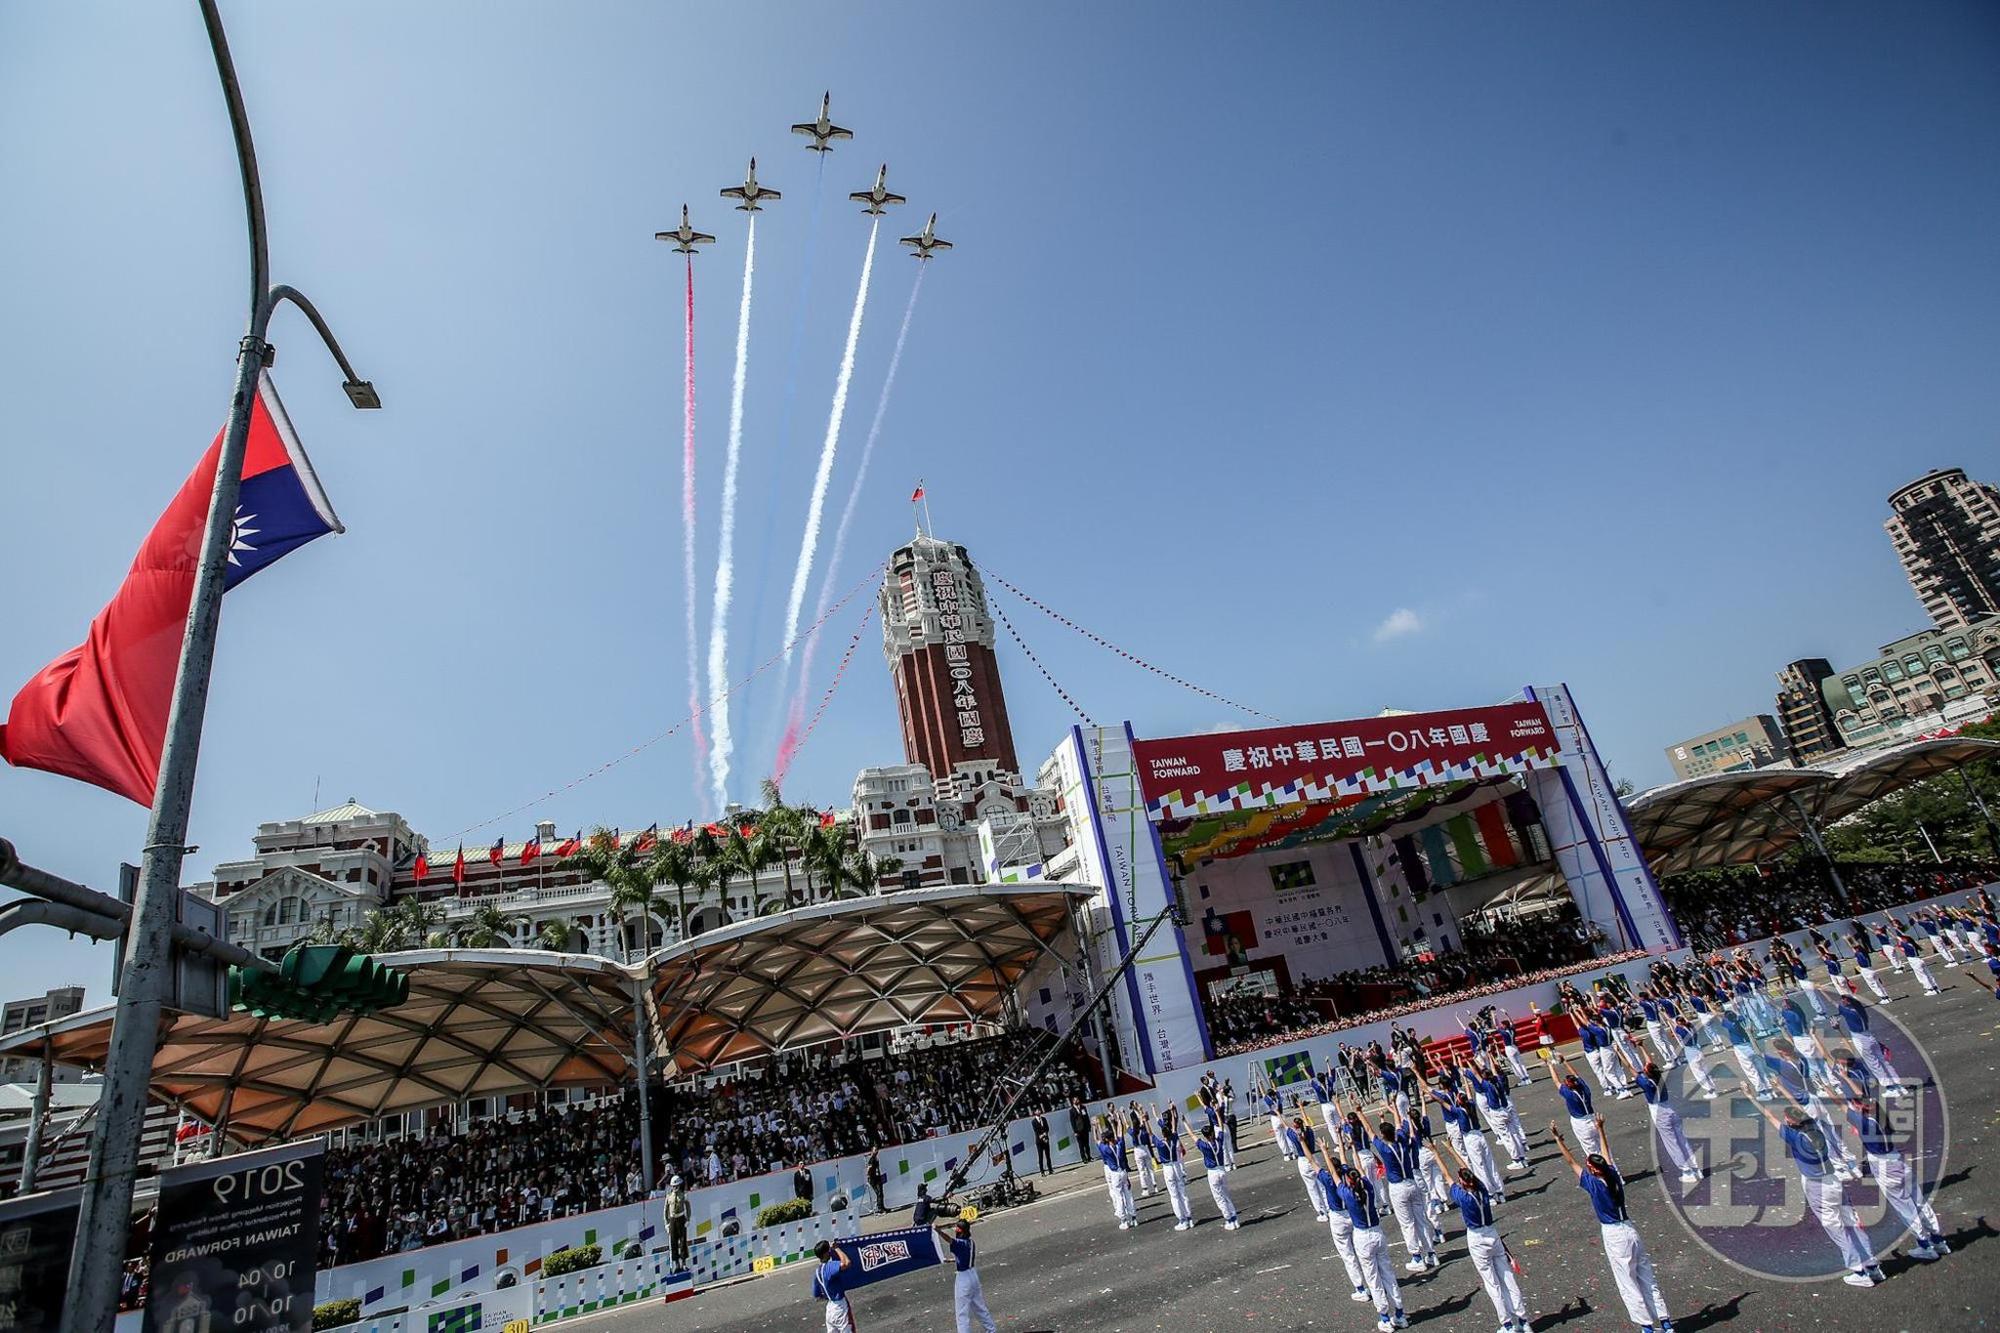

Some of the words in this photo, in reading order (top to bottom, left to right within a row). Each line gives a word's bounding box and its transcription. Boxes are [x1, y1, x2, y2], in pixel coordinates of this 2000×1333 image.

[1513, 718, 1542, 729] TAIWAN
[1510, 726, 1546, 738] FORWARD
[1150, 757, 1187, 769] TAIWAN
[1153, 765, 1201, 779] FORWARD
[1591, 778, 1609, 812] TAIWAN
[1114, 844, 1132, 887] TAIWAN
[1125, 890, 1144, 943] FORWAR
[755, 1257, 772, 1271] 25
[484, 1310, 507, 1319] TAIWAN
[484, 1313, 514, 1325] FORWARD
[508, 1321, 524, 1333] 30
